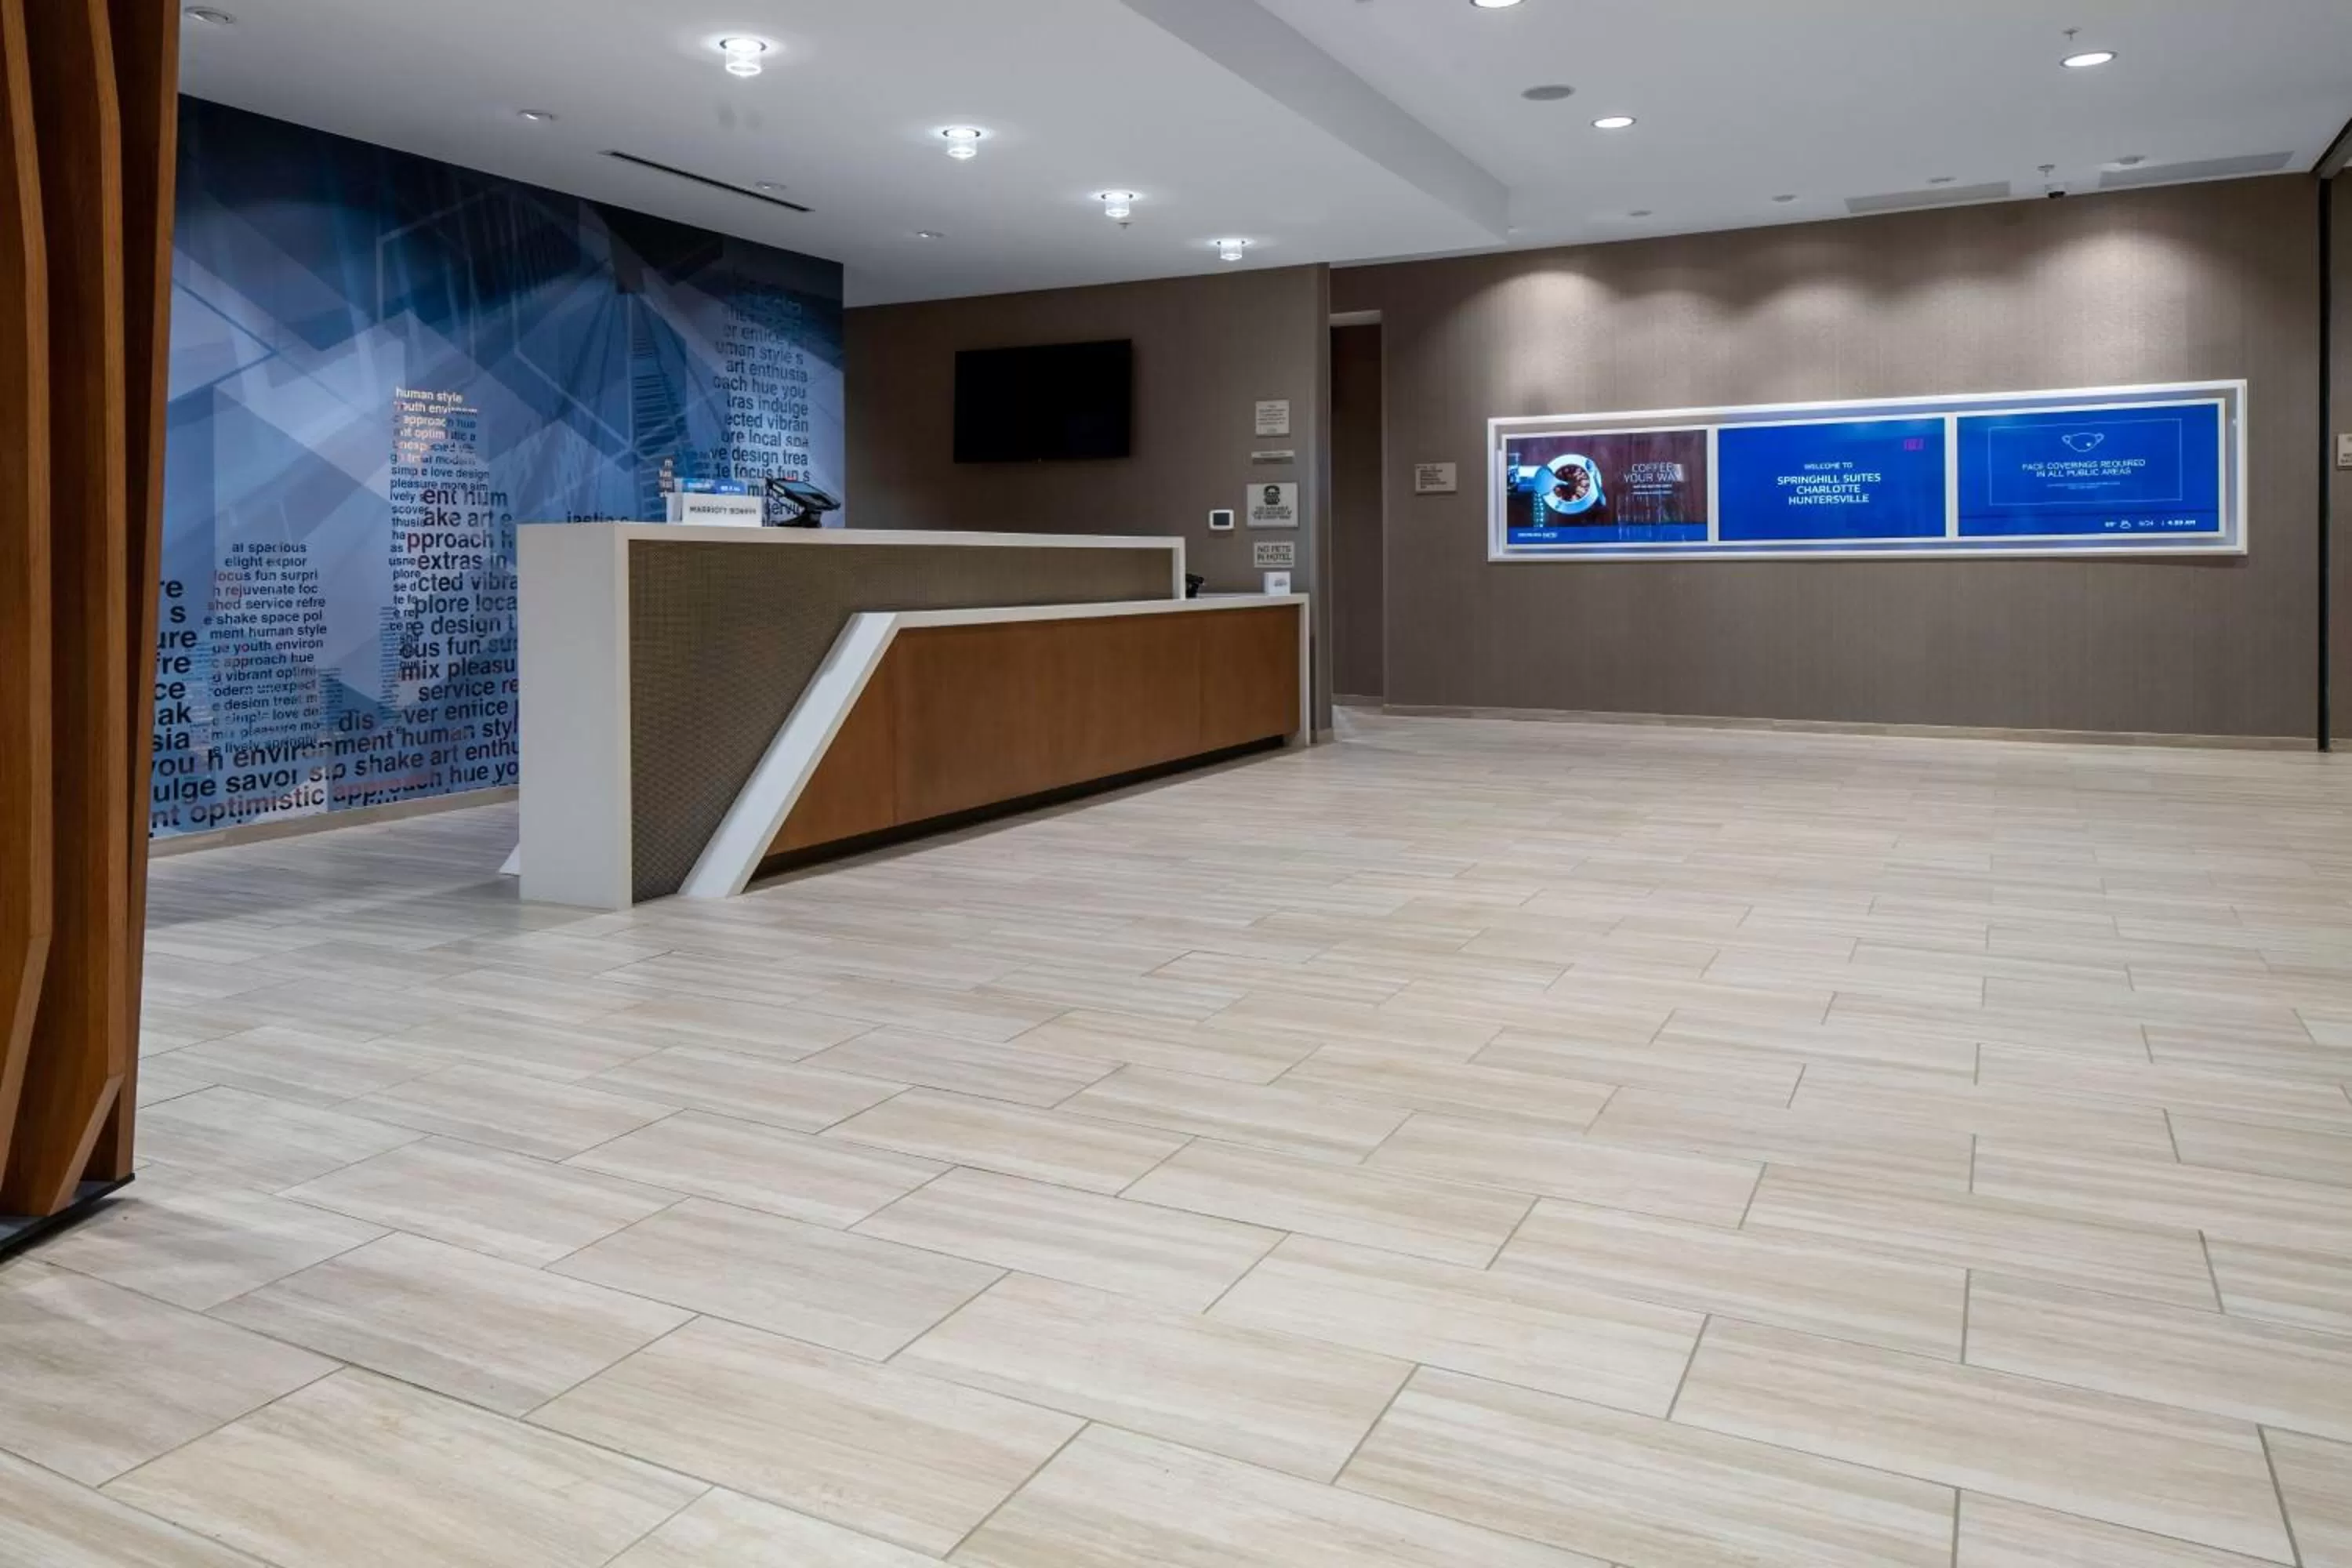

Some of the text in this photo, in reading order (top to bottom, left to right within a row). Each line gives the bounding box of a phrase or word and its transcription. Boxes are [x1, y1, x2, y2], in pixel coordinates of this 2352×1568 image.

[726, 359, 808, 383] art enthusia
[395, 386, 463, 407] human style
[752, 377, 778, 396] hue
[782, 384, 806, 400] you
[759, 394, 808, 419] indulge
[768, 414, 809, 433] vibran
[749, 430, 782, 446] local
[731, 445, 779, 467] design
[782, 449, 808, 466] trea
[2047, 461, 2098, 470] COVERINGS
[2100, 459, 2146, 469] REQUIRED
[430, 466, 452, 477] love
[456, 467, 489, 480] design
[734, 463, 773, 480] focus
[1624, 472, 1653, 483] YOUR
[1777, 473, 1881, 485] SPRINGHILL SUITES
[2047, 470, 2064, 478] ALL
[2067, 468, 2099, 477] PUBLIC
[390, 477, 438, 490] pleasure
[1796, 484, 1861, 495] CHARLOTTE
[1788, 494, 1870, 506] HUNTERSVILLE
[423, 507, 462, 527] ake
[467, 510, 494, 528] art
[248, 542, 307, 556] spacious
[406, 529, 494, 554] pproach
[225, 556, 263, 570] elight
[417, 550, 483, 570] extras
[256, 570, 277, 582] fun
[280, 568, 318, 586] surpri
[417, 572, 518, 592] cted vibra
[225, 583, 296, 597] rejuvenate
[299, 583, 318, 594] foc
[245, 597, 293, 610] service
[296, 596, 325, 608] refre
[415, 593, 470, 619] plore
[475, 593, 517, 612] loca
[169, 605, 187, 624] s
[216, 612, 258, 625] shake
[261, 612, 299, 626] space
[209, 623, 327, 640] ment human style
[430, 615, 501, 638] design
[234, 640, 271, 655] youth
[275, 638, 324, 651] environ
[447, 636, 481, 655] fun
[223, 655, 287, 670] approach
[291, 652, 314, 663] hue
[447, 657, 516, 683] pleasu
[226, 668, 273, 681] vibrant
[418, 678, 495, 702] service
[224, 698, 270, 712] design
[445, 698, 509, 720] entice
[272, 709, 299, 721] love
[153, 777, 217, 804] ulge
[354, 750, 424, 776] shake
[430, 746, 459, 766] art
[465, 737, 519, 761] enthu
[190, 786, 325, 827] optimistic
[449, 765, 488, 784] hue
